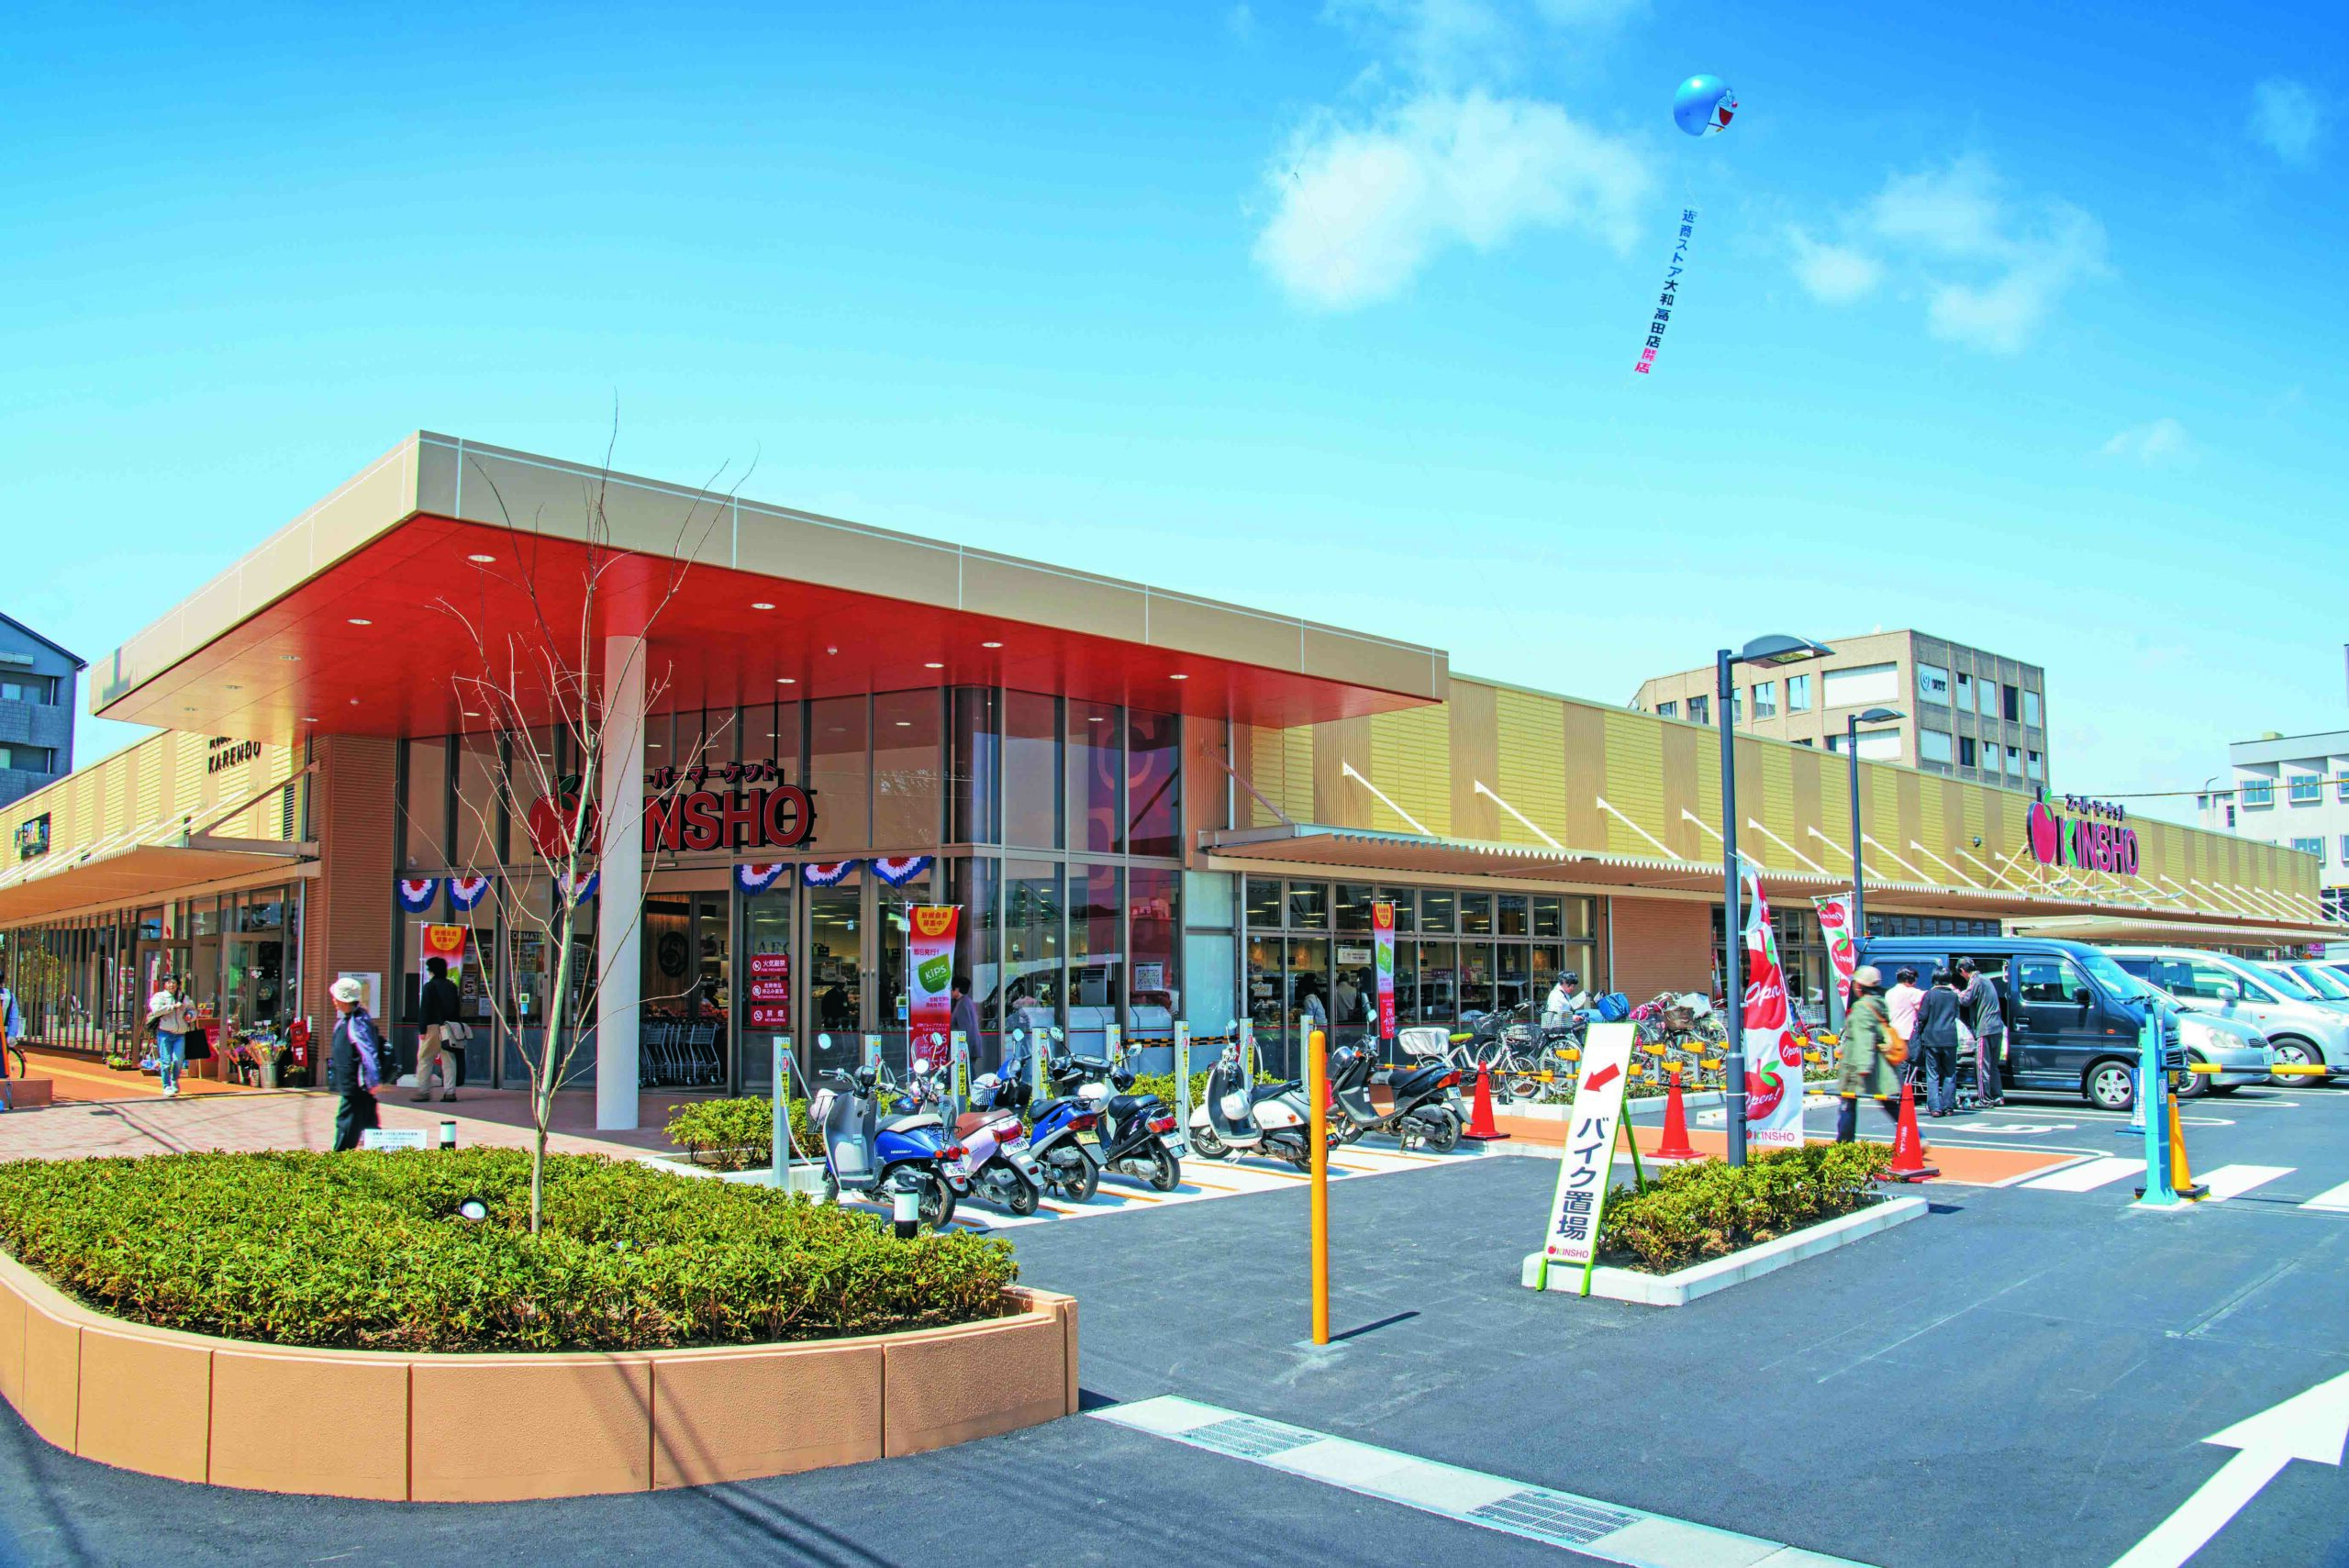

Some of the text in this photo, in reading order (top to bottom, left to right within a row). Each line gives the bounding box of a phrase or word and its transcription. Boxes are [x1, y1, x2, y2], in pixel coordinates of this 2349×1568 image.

[207, 740, 262, 774] KARENDO
[643, 759, 778, 789] パーマーケット
[2058, 816, 2140, 877] KINSHO
[1753, 1130, 1795, 1141] KINSHO
[1556, 1117, 1609, 1240] バイク置場
[1556, 1248, 1589, 1259] KINSHO
